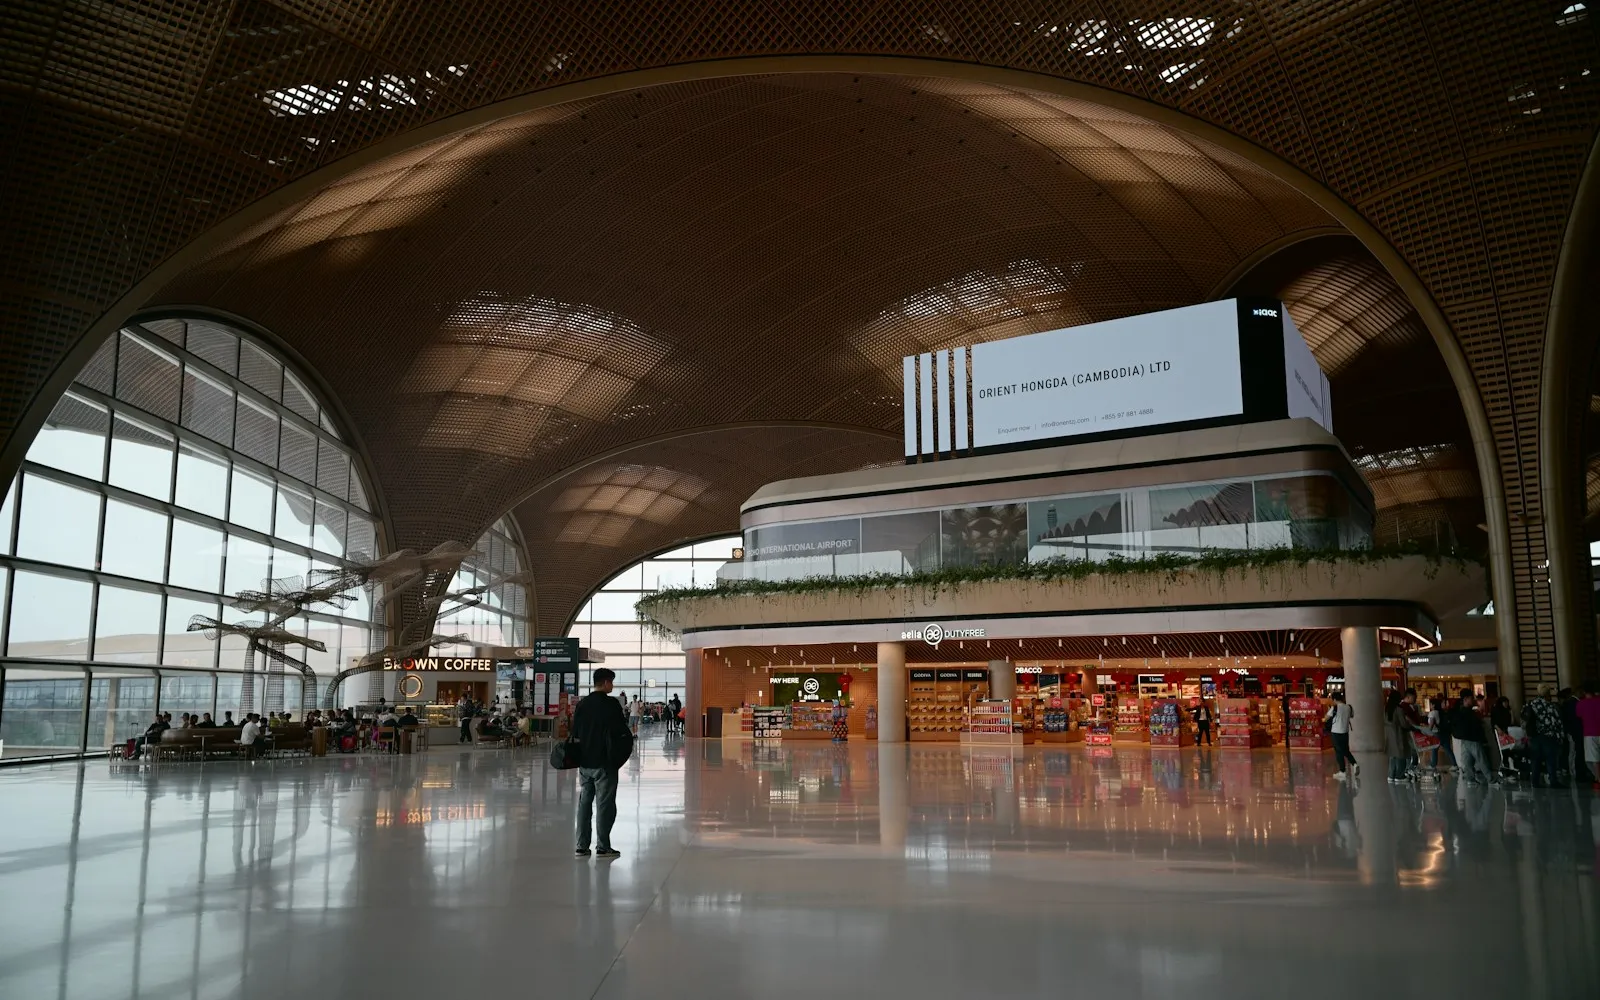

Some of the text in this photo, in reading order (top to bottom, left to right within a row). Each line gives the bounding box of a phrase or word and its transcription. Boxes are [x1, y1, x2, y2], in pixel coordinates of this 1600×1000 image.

[979, 360, 1171, 399] ORIENT HONGDA (CAMBODIA) LTD
[1117, 411, 1125, 419] 97
[761, 542, 816, 554] INTERNATIONAL
[817, 539, 853, 550] AIRPORT
[901, 630, 922, 639] aella
[444, 658, 491, 671] COFFEE
